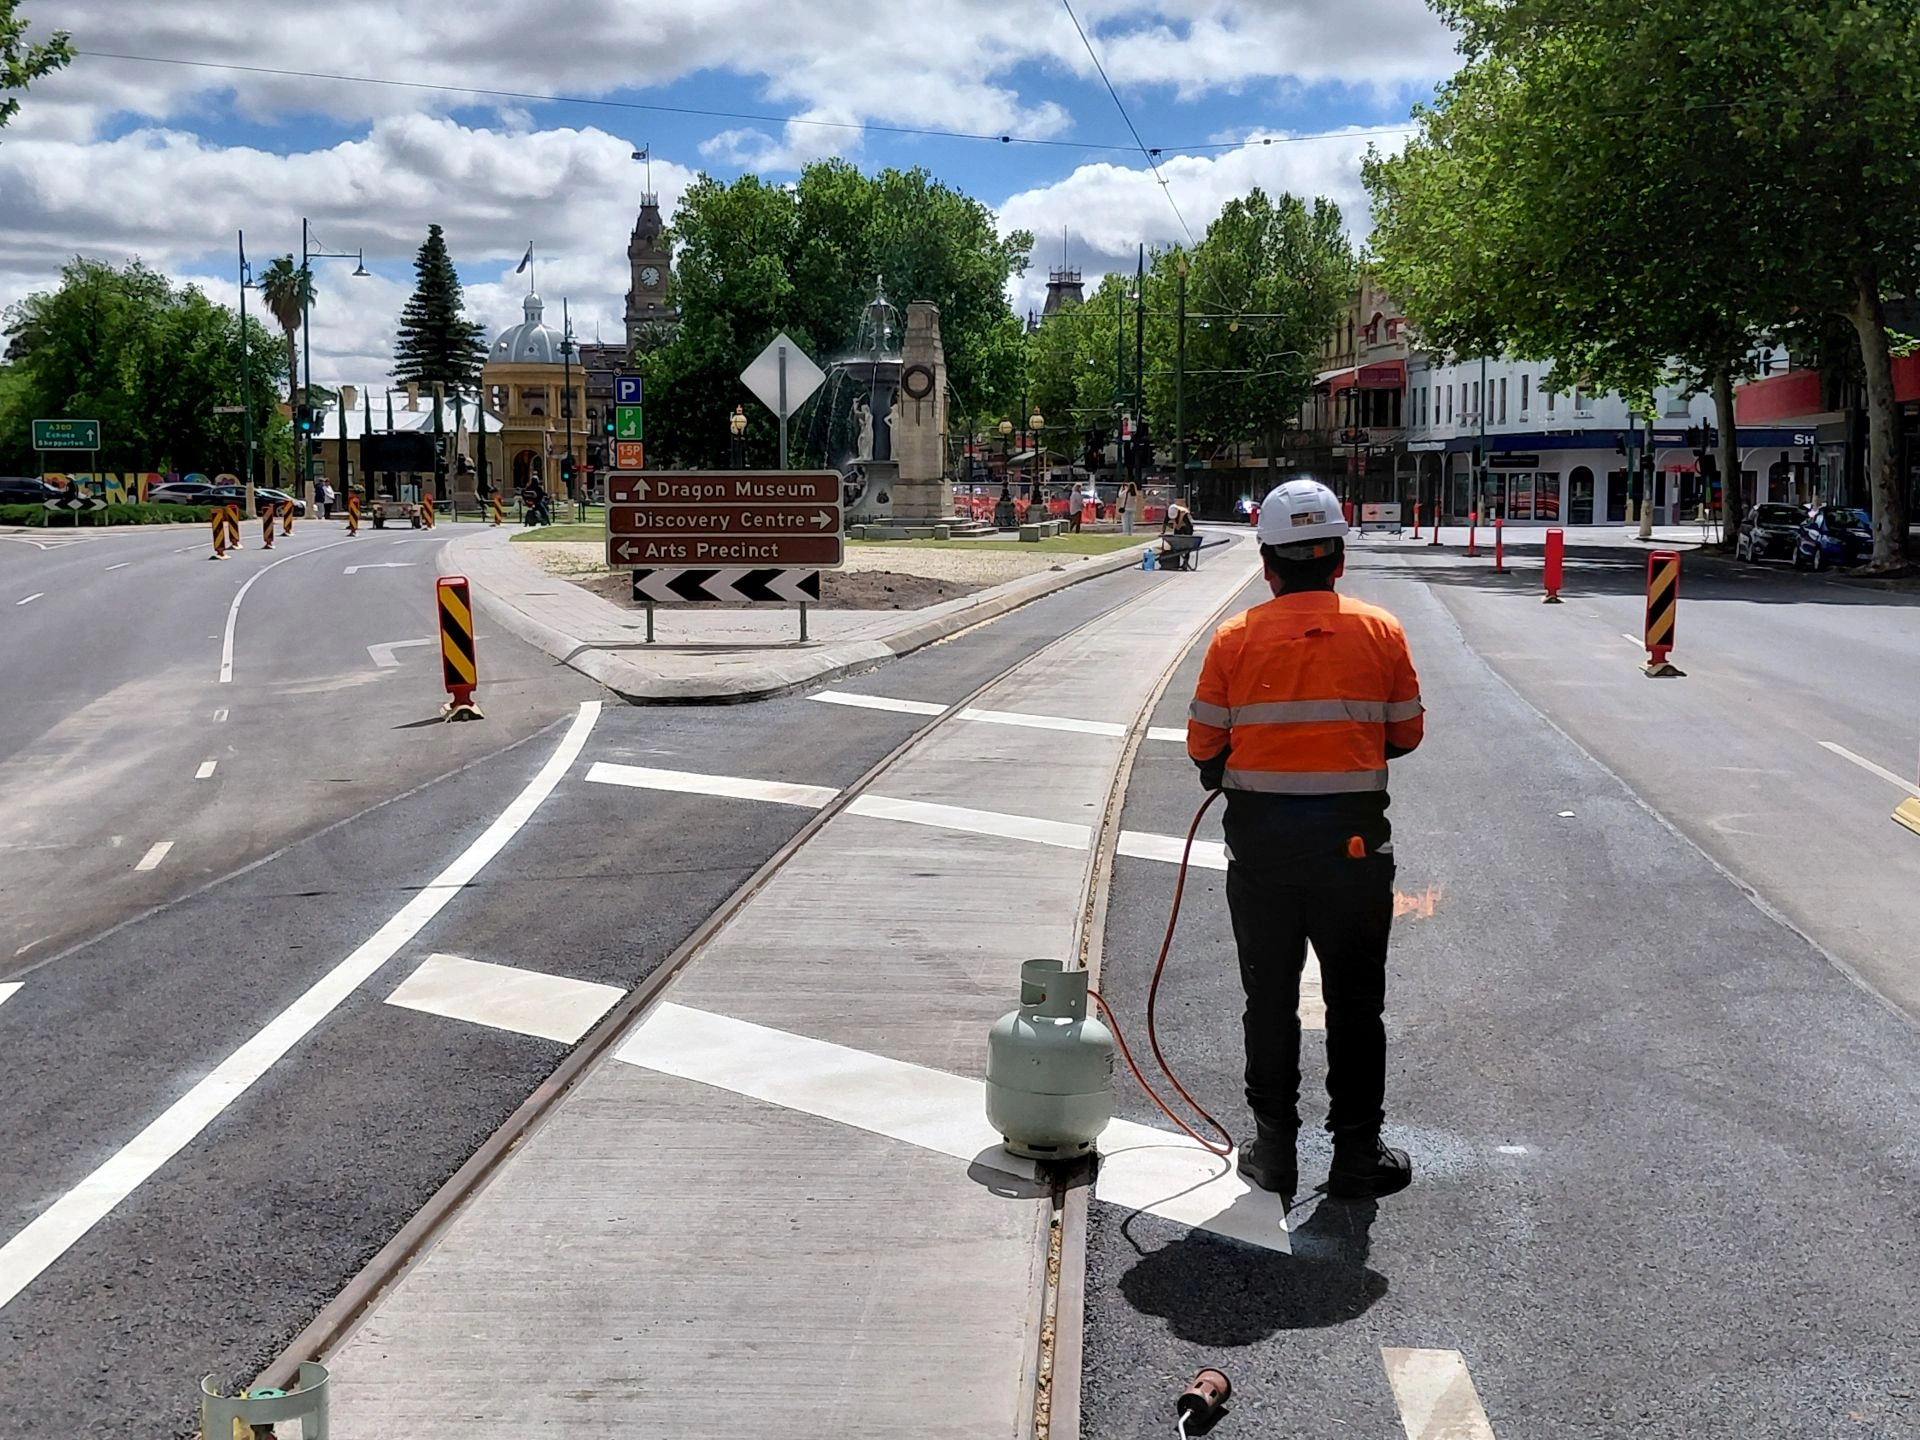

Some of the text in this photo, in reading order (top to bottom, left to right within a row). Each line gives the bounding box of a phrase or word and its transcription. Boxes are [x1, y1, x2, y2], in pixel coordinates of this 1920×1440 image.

[621, 381, 636, 400] P
[625, 409, 634, 420] P
[657, 481, 816, 501] Dragon Museum
[634, 511, 805, 530] Discovery Centre
[645, 542, 779, 558] Arts Precinct
